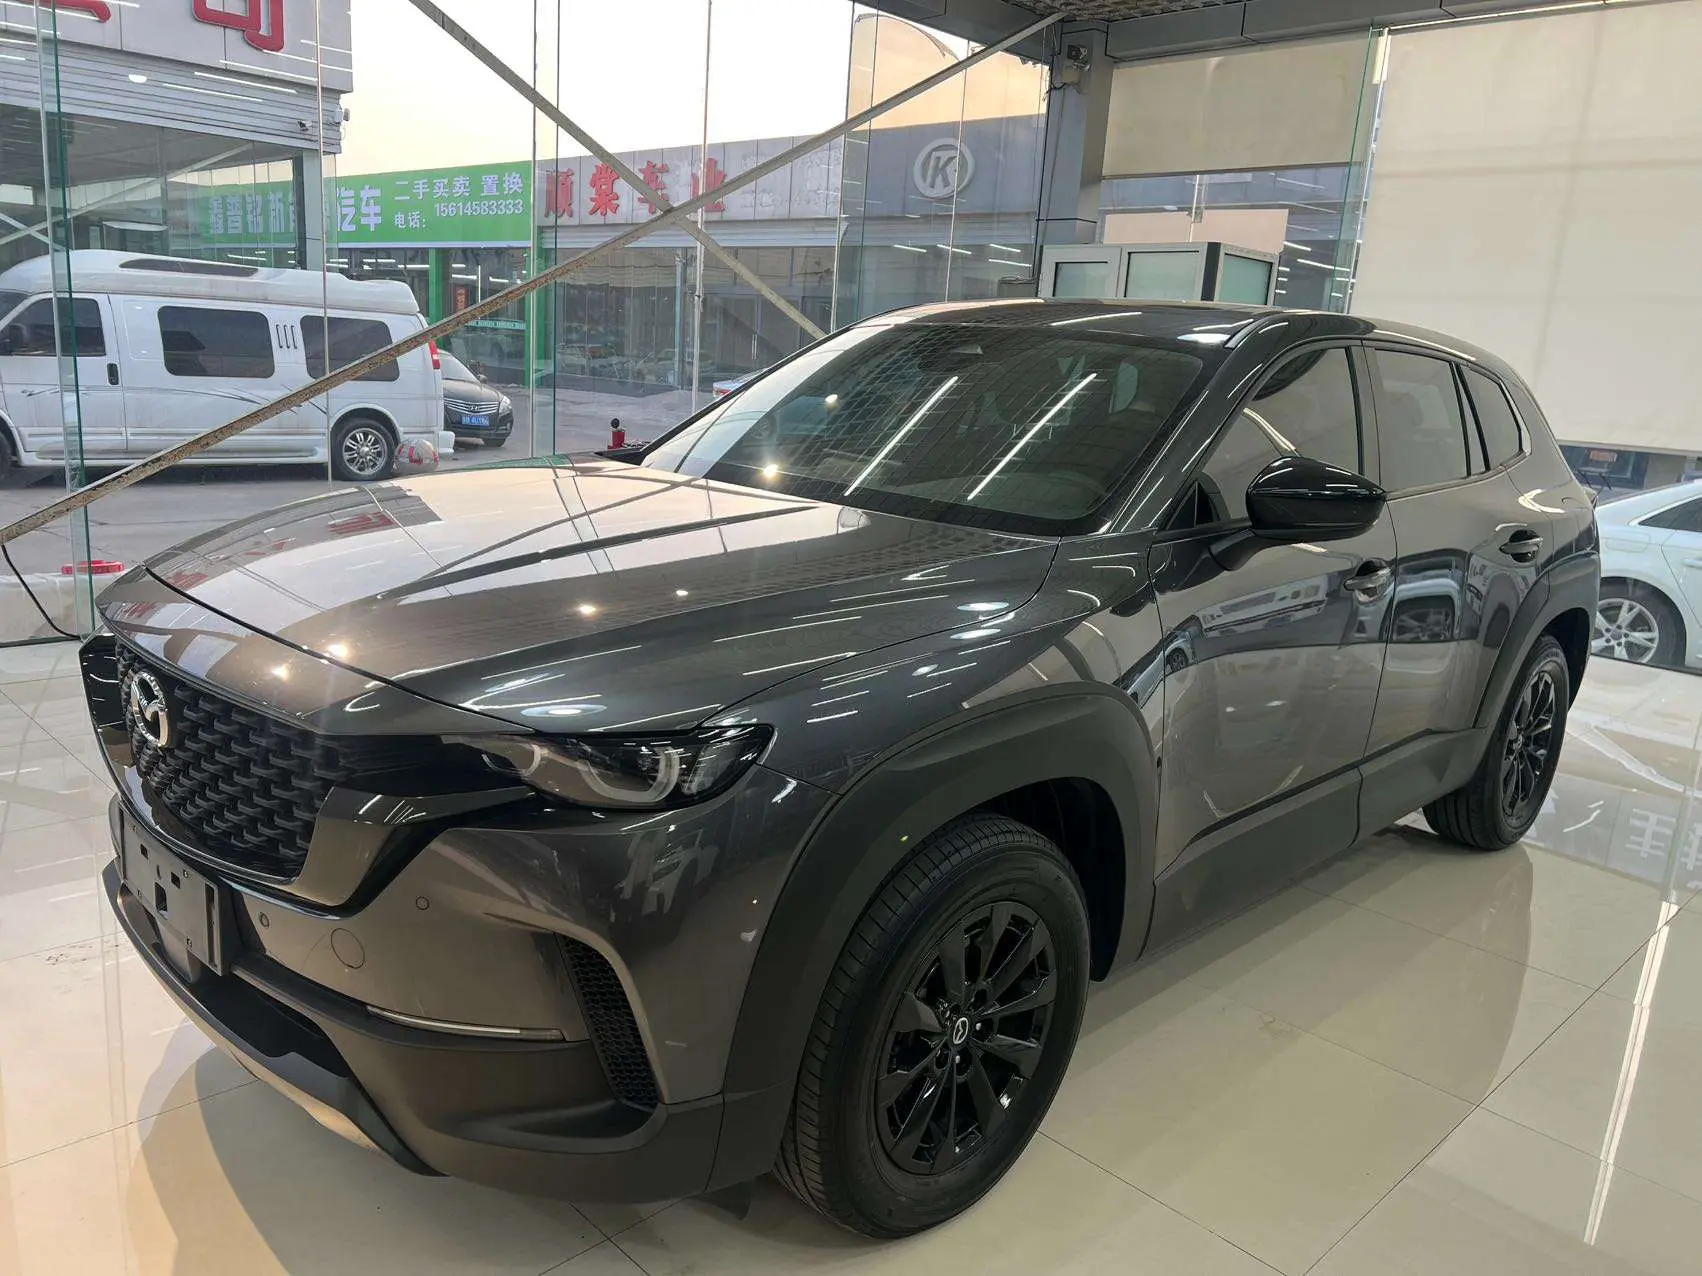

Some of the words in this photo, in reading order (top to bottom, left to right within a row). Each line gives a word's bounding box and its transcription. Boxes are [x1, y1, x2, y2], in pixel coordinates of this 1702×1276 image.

[394, 176, 471, 201] 二手买卖
[481, 172, 523, 195] 置换
[394, 211, 427, 229] 电话:
[434, 199, 523, 217] 15614583333
